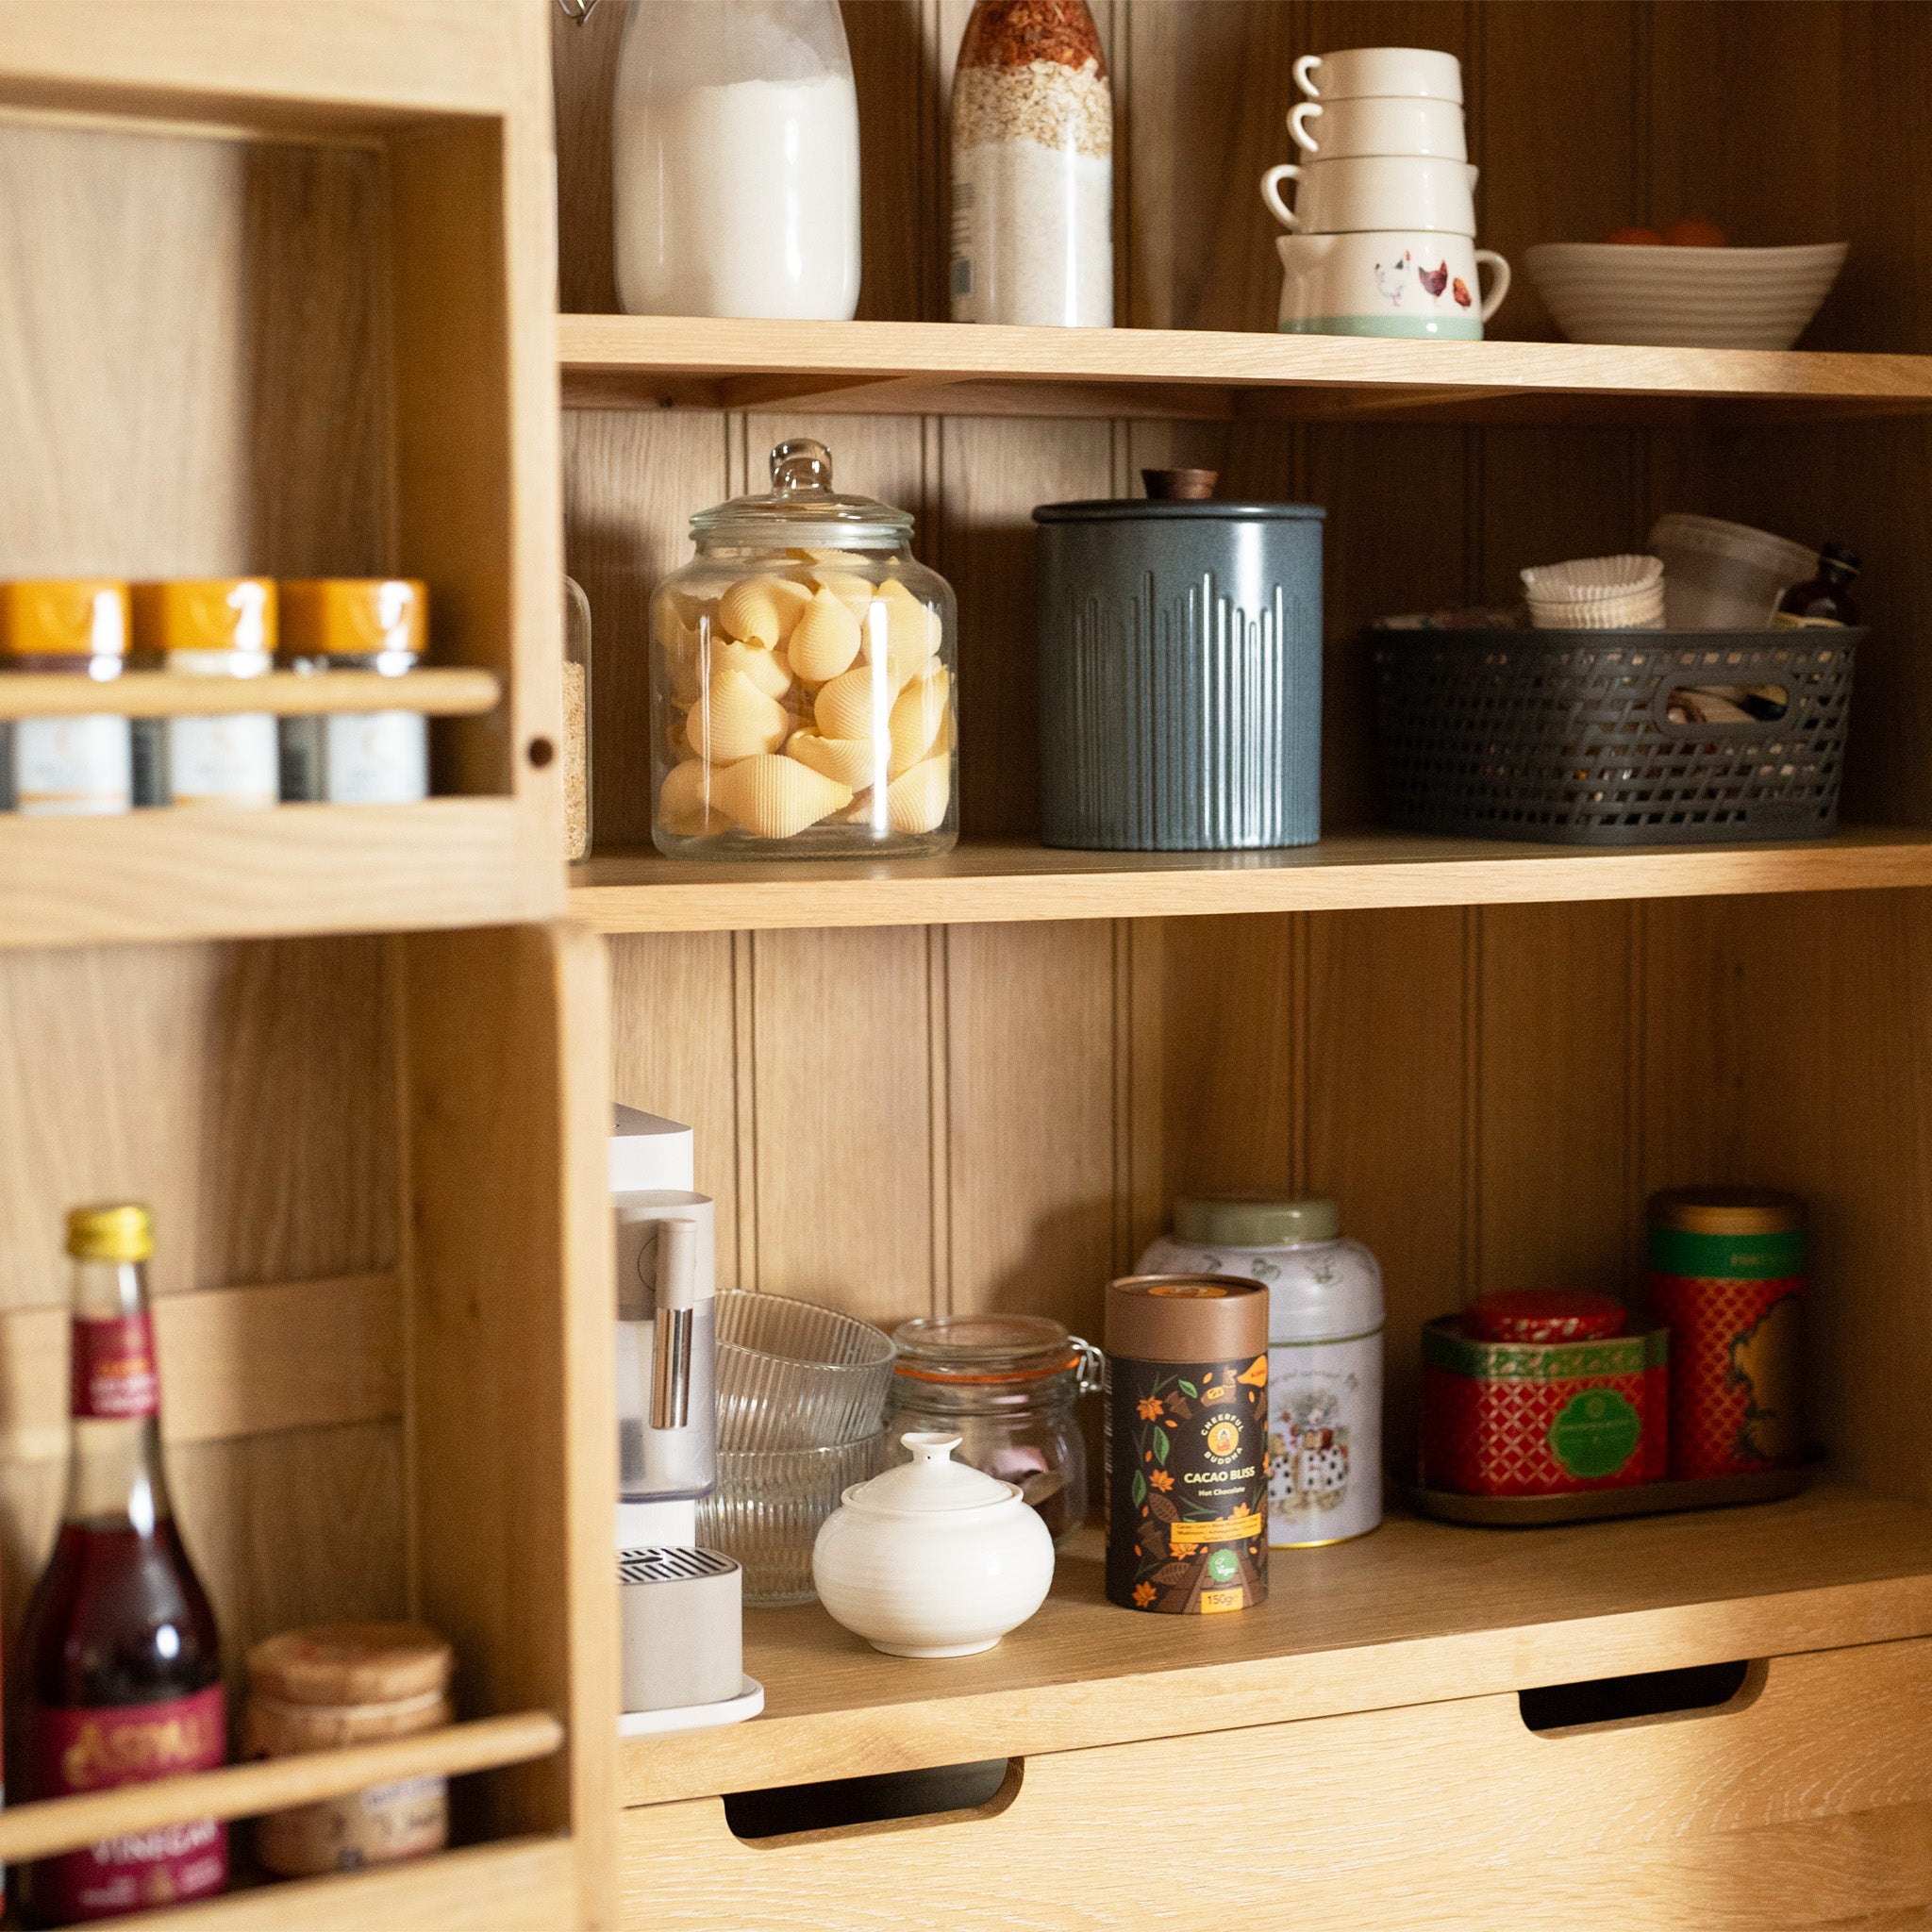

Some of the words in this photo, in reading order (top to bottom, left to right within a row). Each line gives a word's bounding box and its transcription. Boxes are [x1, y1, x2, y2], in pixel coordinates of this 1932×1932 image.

[1201, 1413, 1244, 1436] CHEERFUL
[1204, 1447, 1243, 1465] BUDDHA
[1184, 1471, 1228, 1483] CACAO
[1230, 1466, 1255, 1480] BLISS
[1213, 1487, 1245, 1496] Chocolate
[1208, 1593, 1233, 1607] 150g
